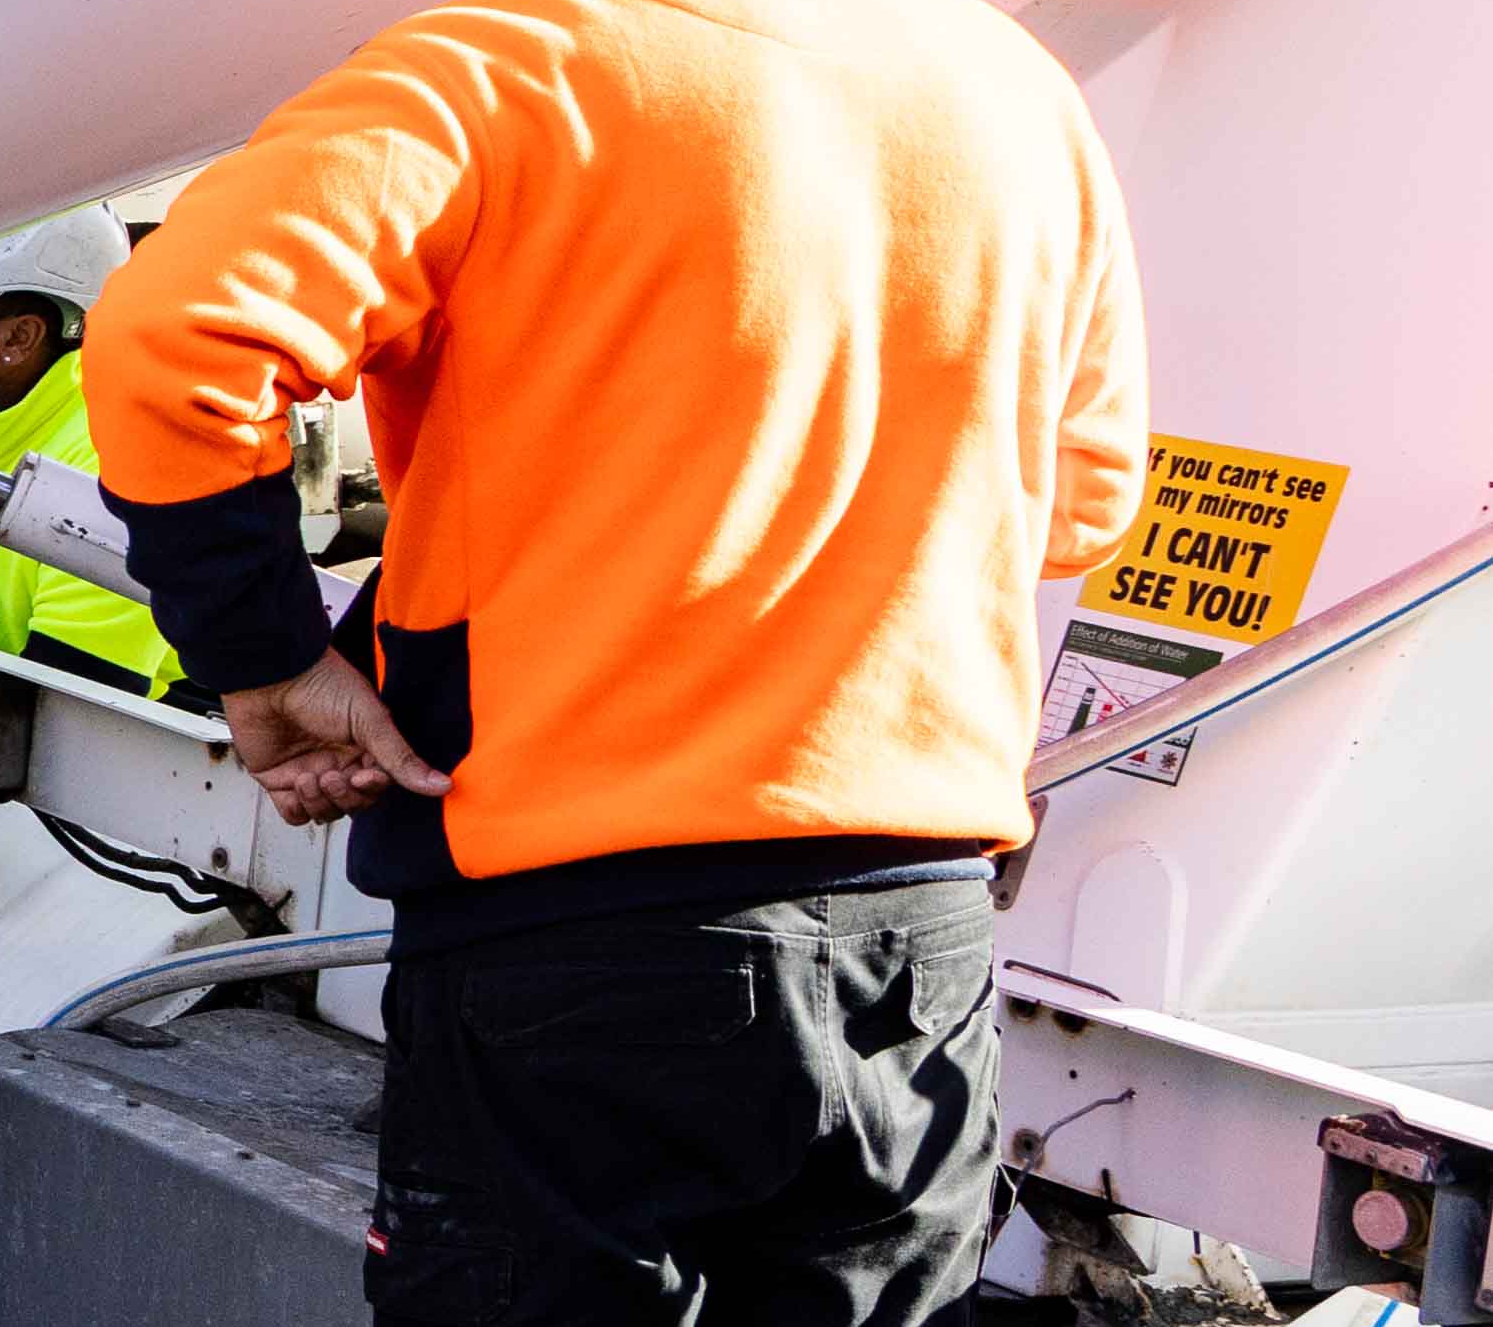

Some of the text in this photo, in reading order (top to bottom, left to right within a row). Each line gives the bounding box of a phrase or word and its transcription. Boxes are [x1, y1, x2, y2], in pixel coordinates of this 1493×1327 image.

[1168, 454, 1213, 481] you
[1216, 462, 1279, 494] can't
[1282, 475, 1326, 503] see
[1154, 485, 1289, 530] my mirrors
[1141, 522, 1271, 580] I CAN'T
[1109, 565, 1272, 632] SEE YOU!
[1071, 624, 1098, 641] Effect
[1107, 632, 1148, 652] Addition
